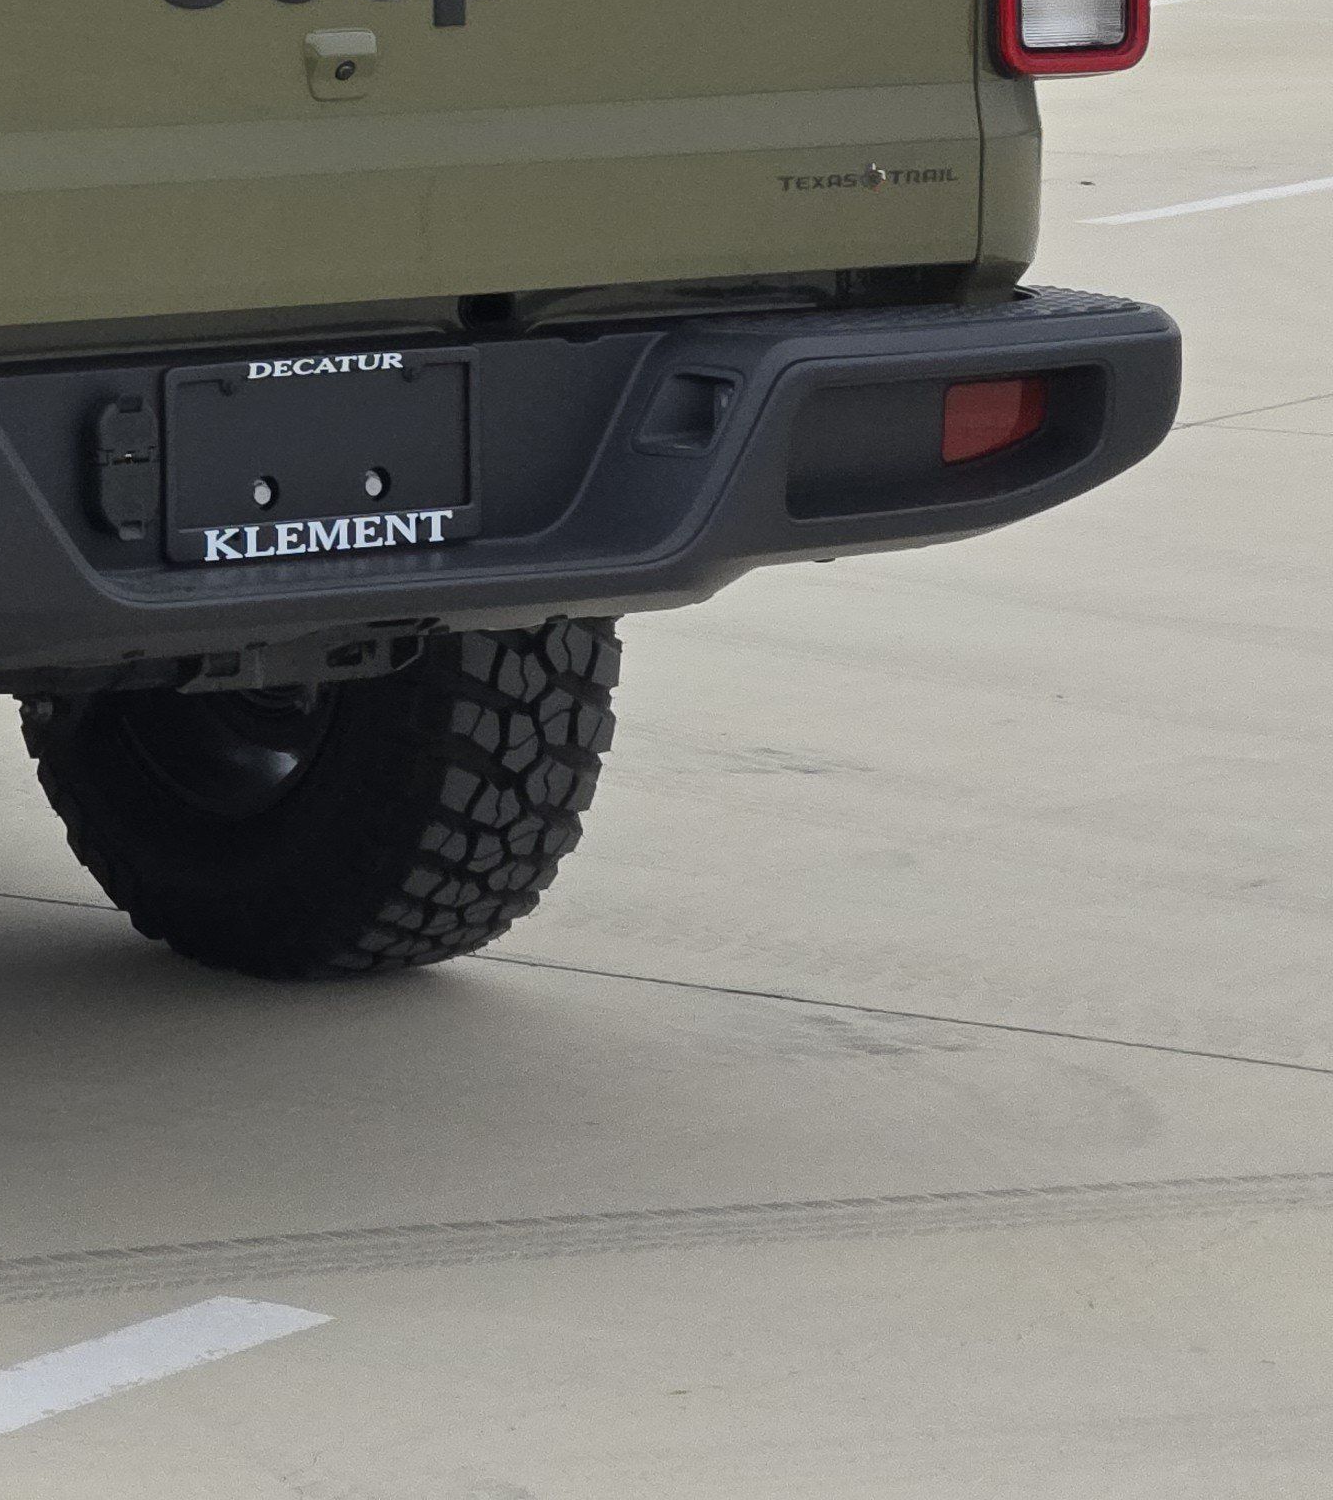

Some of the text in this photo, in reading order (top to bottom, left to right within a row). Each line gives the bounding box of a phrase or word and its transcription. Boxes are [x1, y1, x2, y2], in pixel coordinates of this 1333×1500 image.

[777, 167, 959, 192] TEXAS TRAIL
[247, 352, 404, 380] DECATUR
[203, 510, 453, 562] KLEMENT
